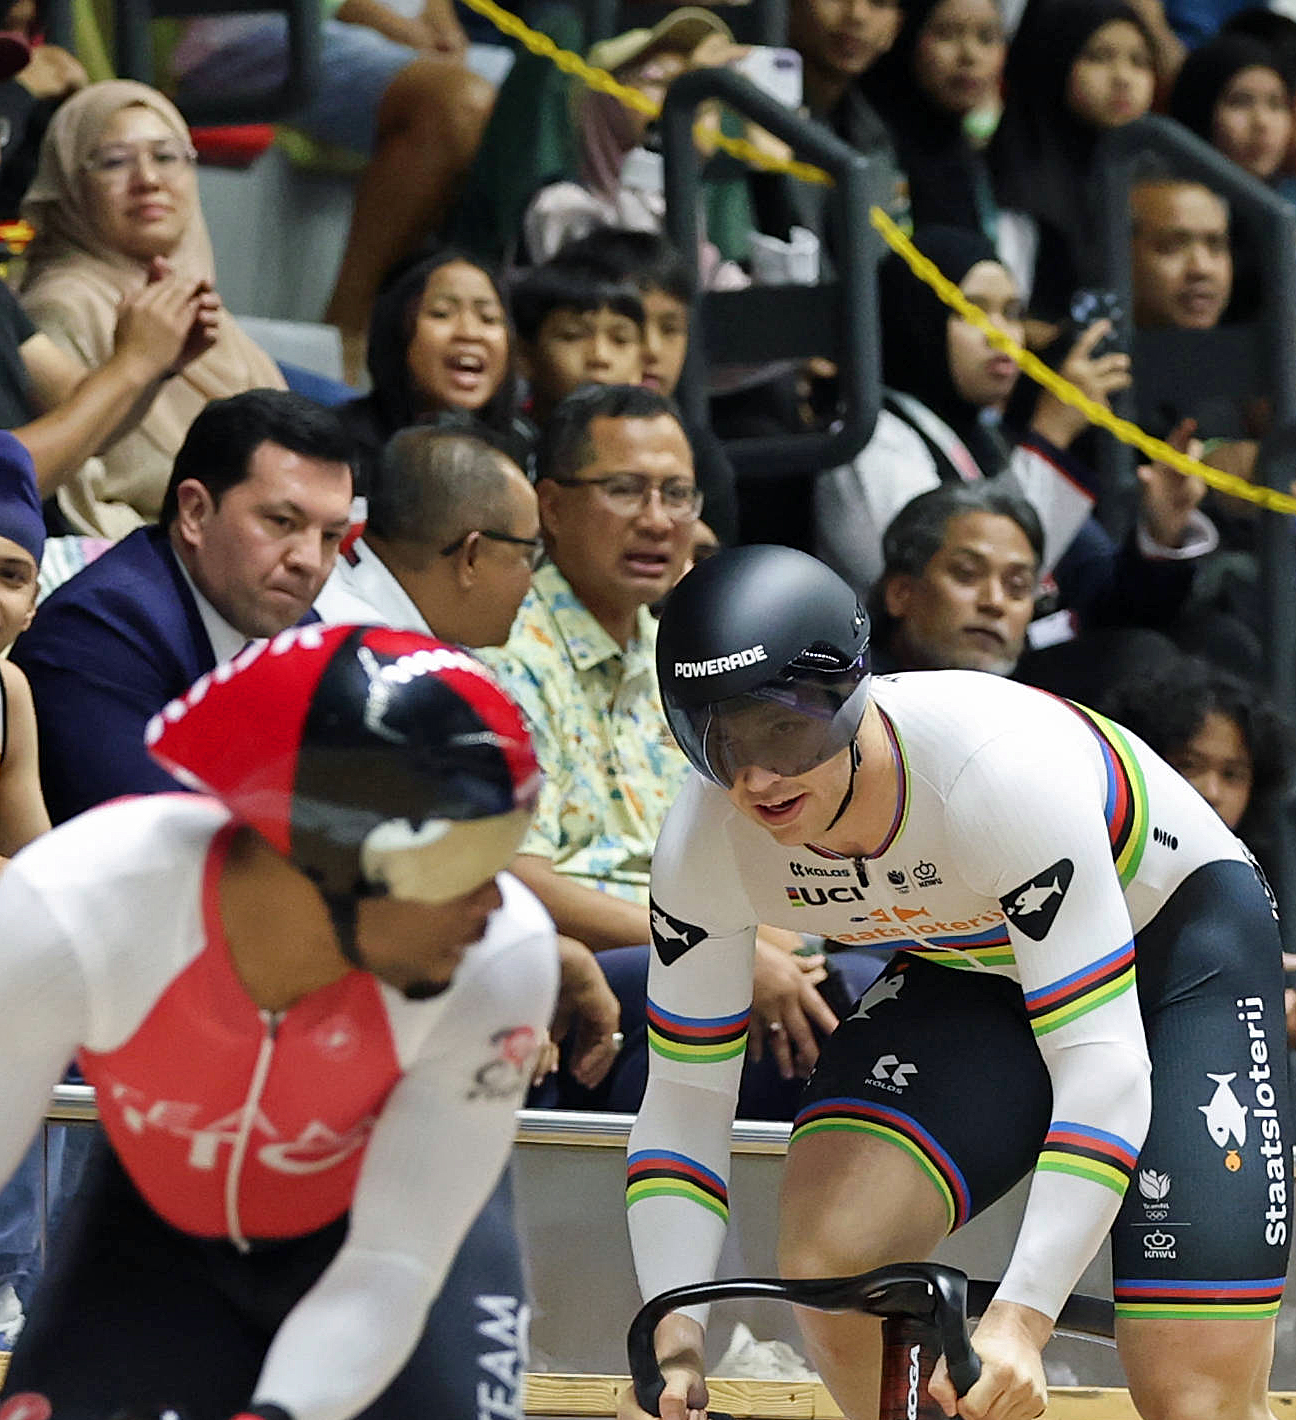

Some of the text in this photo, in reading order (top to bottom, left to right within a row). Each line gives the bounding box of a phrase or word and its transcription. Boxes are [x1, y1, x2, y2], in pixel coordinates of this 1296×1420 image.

[674, 644, 768, 678] POWERADE
[799, 886, 865, 905] UCI
[1236, 997, 1288, 1246] Staatsloterij
